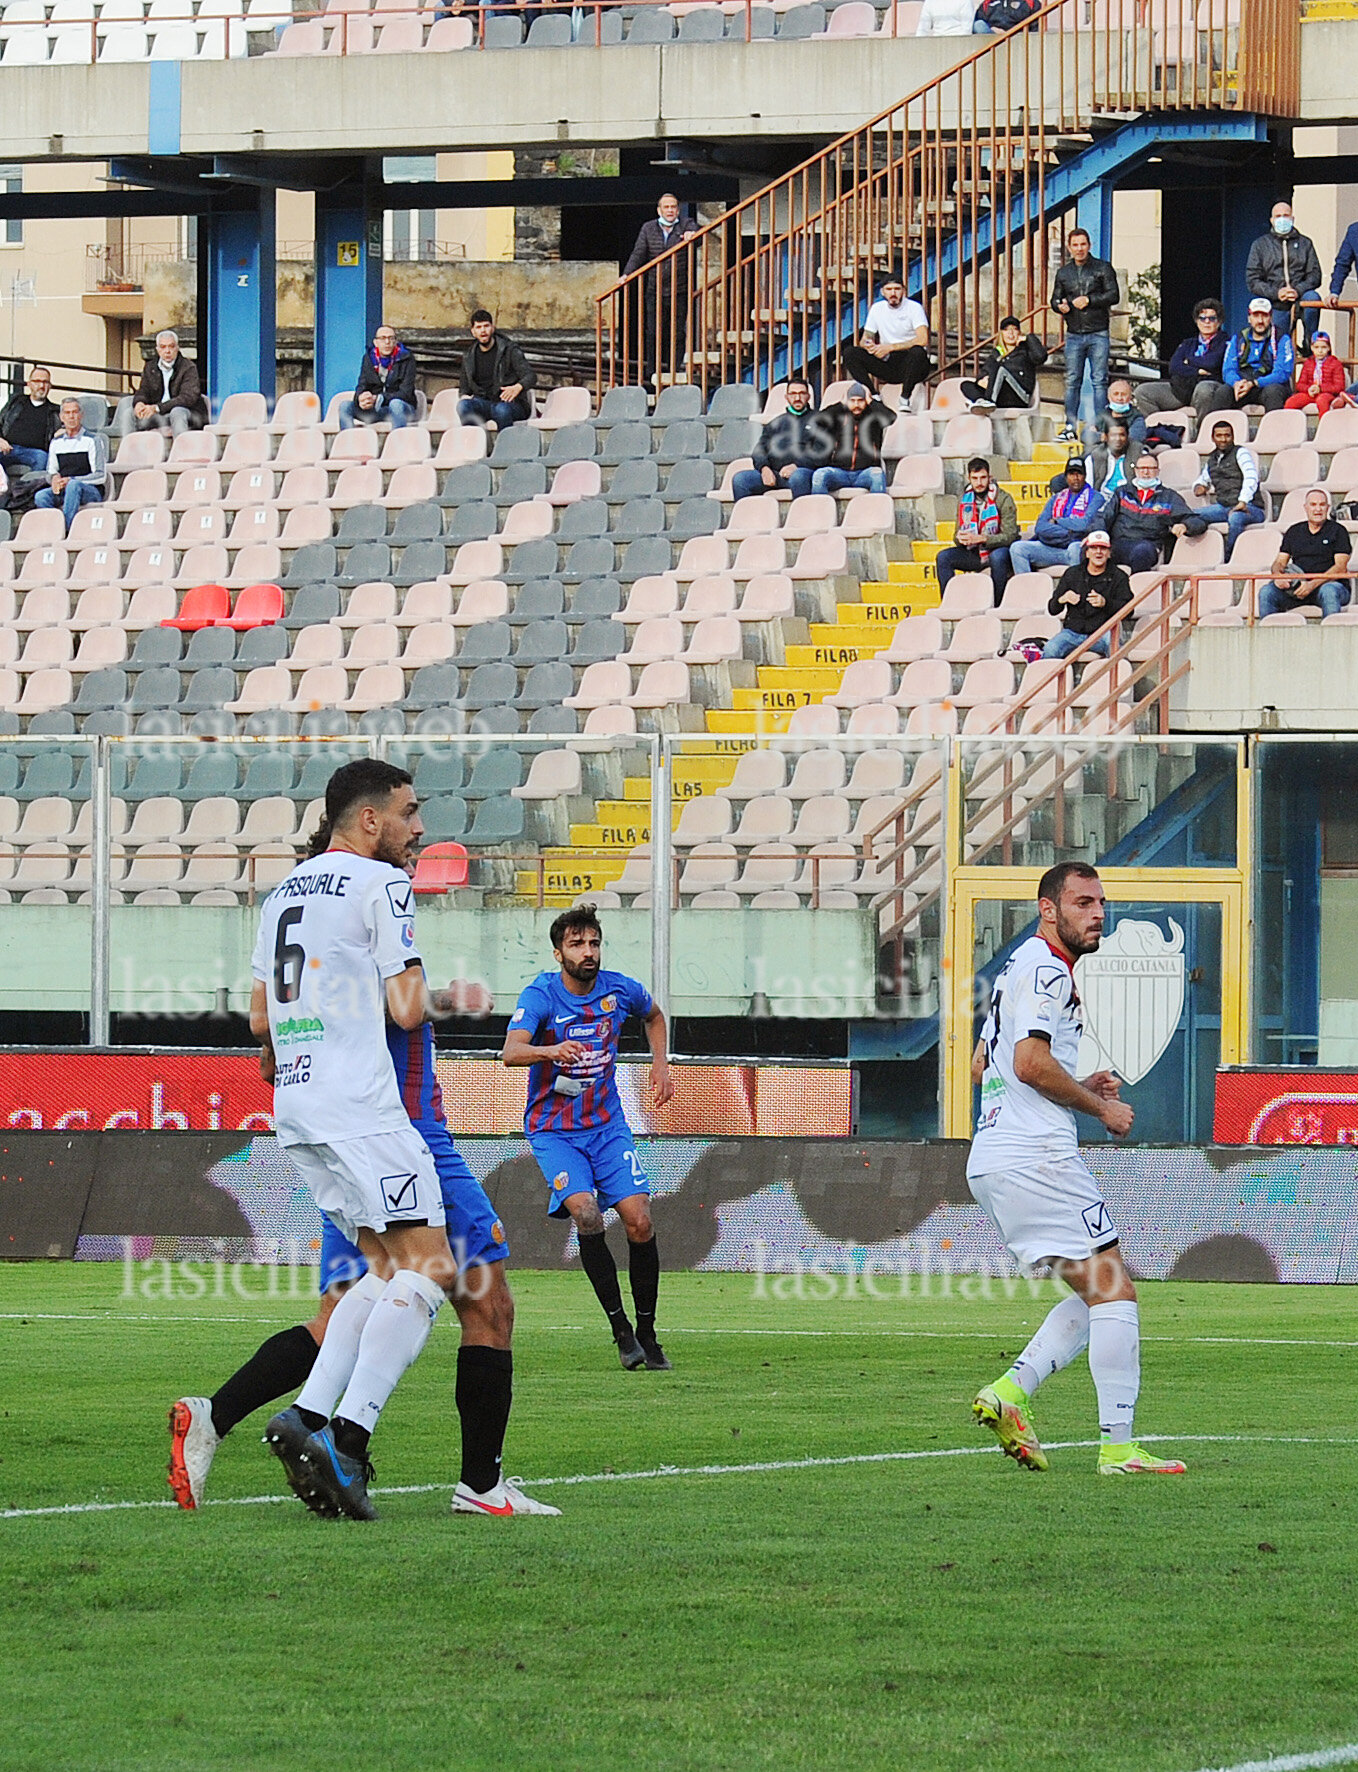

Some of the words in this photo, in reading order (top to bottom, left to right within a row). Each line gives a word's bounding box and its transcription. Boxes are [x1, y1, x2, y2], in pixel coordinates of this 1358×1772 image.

[866, 606, 900, 620] FILA
[903, 605, 912, 618] 9
[762, 693, 796, 707] FILA
[803, 692, 812, 706] 7
[602, 828, 636, 843] FILA
[641, 829, 651, 843] 4
[273, 905, 306, 1004] 6
[1090, 958, 1129, 973] CALCIO
[1131, 958, 1177, 973] CATANIA
[283, 1071, 311, 1087] CARLO
